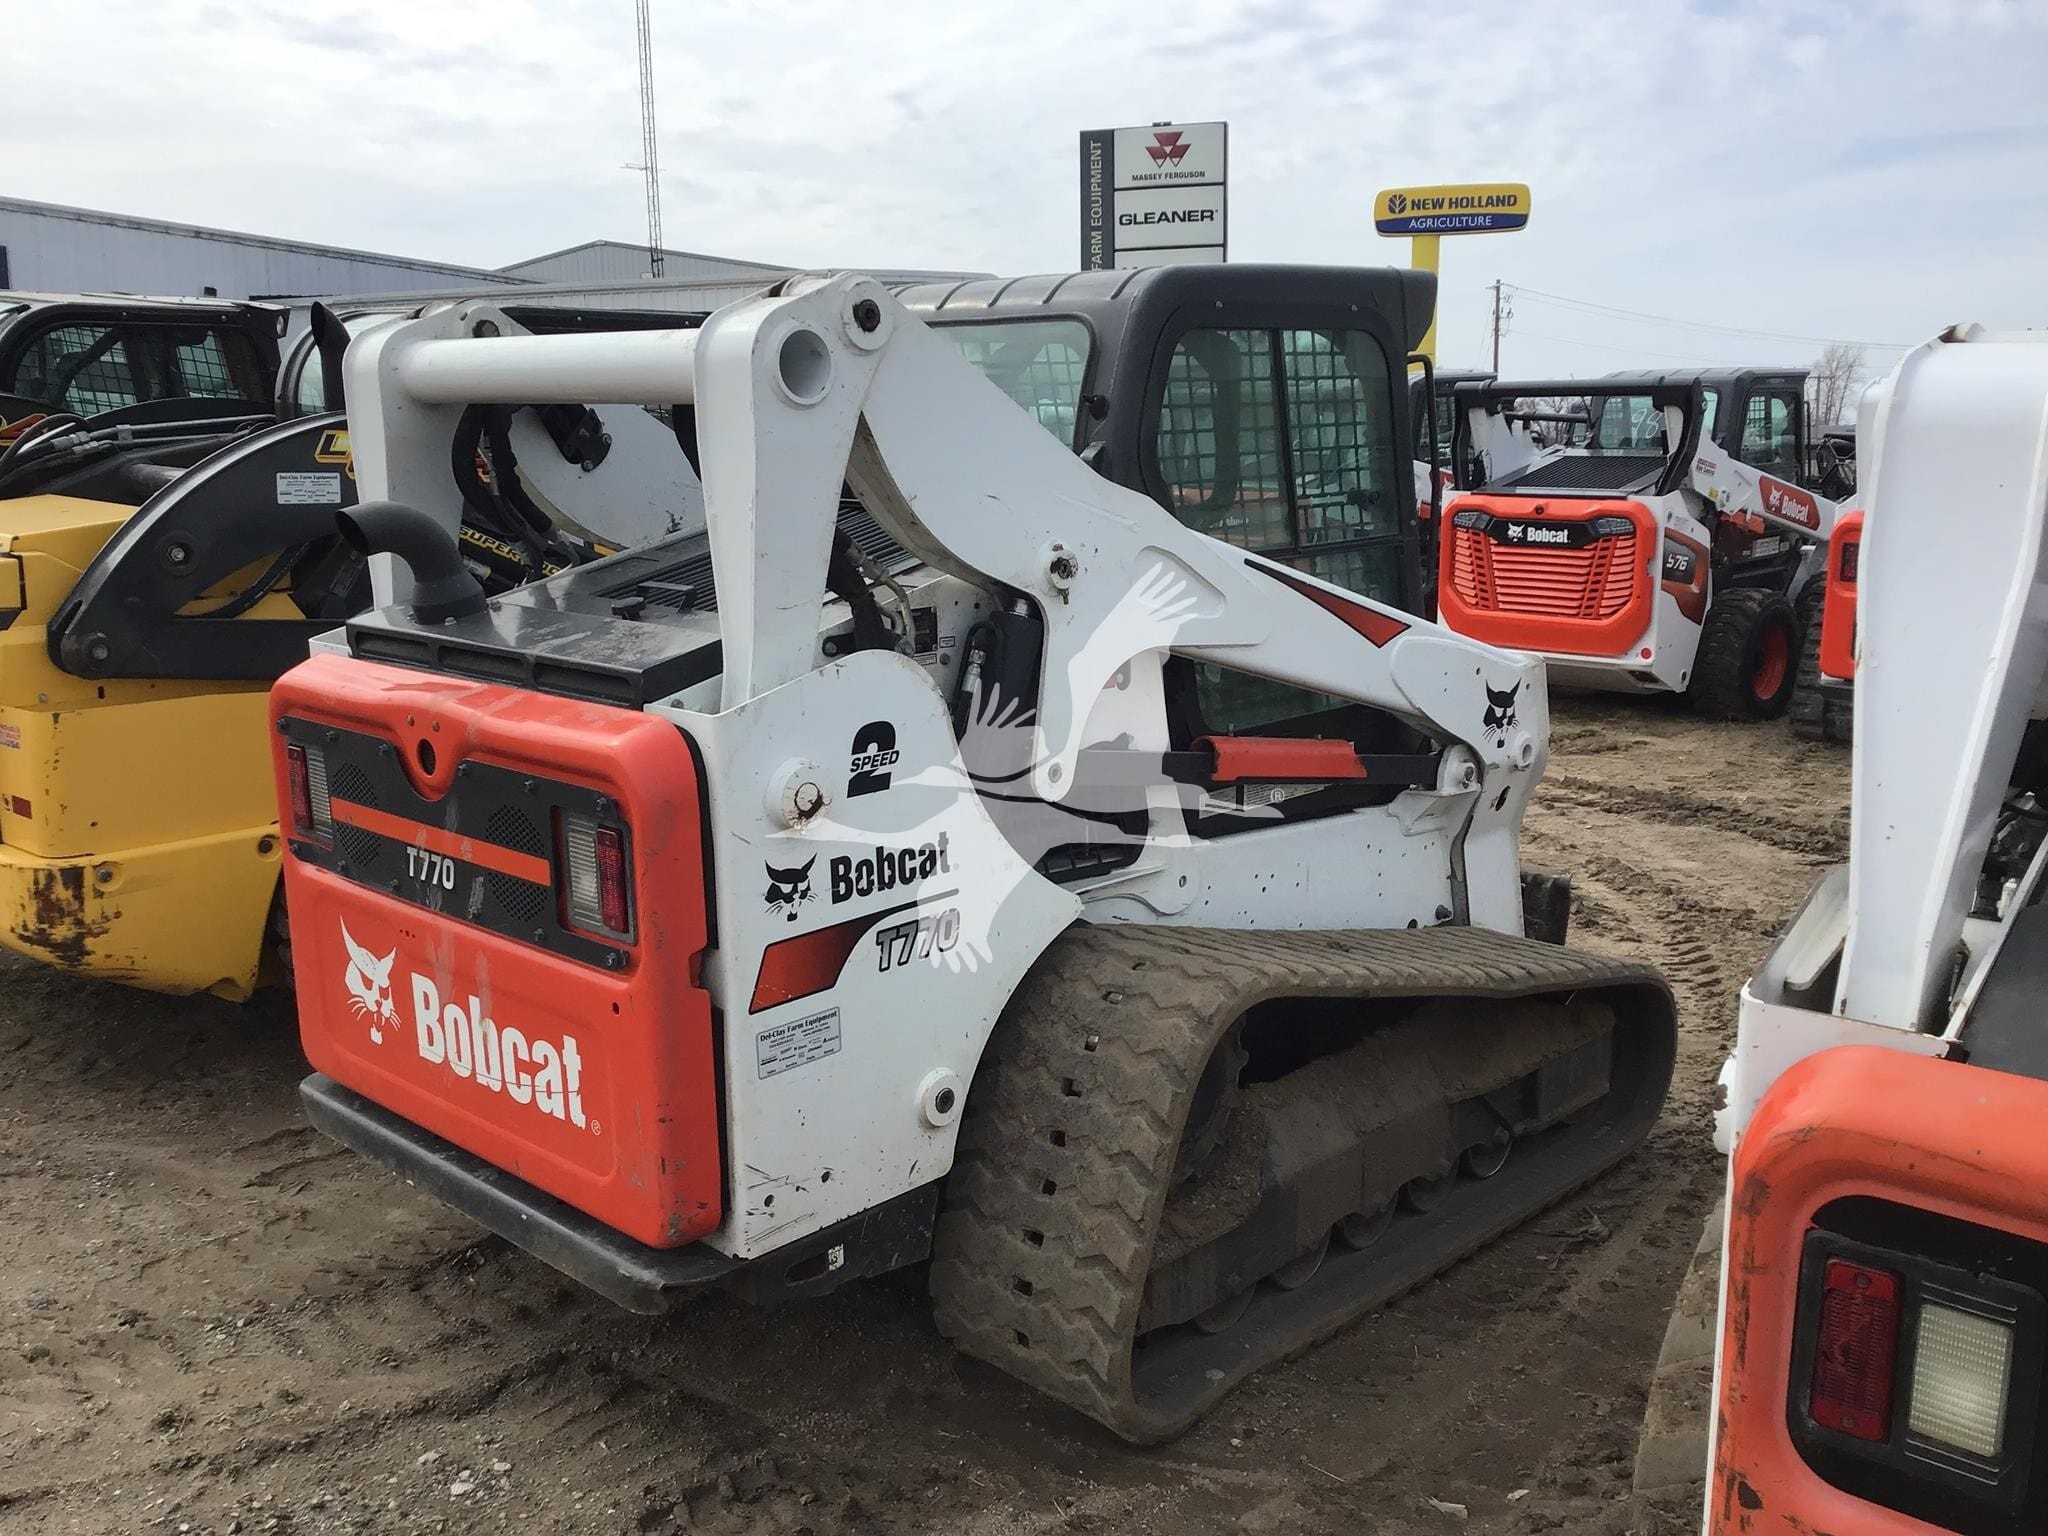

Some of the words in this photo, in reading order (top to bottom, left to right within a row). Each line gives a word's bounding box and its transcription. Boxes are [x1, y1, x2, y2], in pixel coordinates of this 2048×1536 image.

[1091, 140, 1102, 226] EQUIPMENT
[1132, 173, 1162, 181] MASSEY
[1164, 170, 1206, 180] FERGUSON
[1119, 209, 1216, 226] GLEANER
[1411, 197, 1445, 211] NEW
[1448, 194, 1518, 209] HOLLAND
[1408, 216, 1492, 229] AGRICULTURE
[1091, 231, 1102, 271] FARM
[1781, 495, 1809, 522] Bobcat
[1527, 527, 1569, 543] Bobcat
[847, 720, 896, 798] 2
[850, 750, 900, 773] SPEED
[406, 846, 455, 890] T770
[829, 831, 950, 905] Bobcat
[875, 907, 961, 973] T770
[760, 1027, 786, 1042] Del-Clay
[787, 1022, 804, 1033] Farm
[805, 1010, 837, 1027] Equipment
[410, 971, 587, 1131] Bobcat
